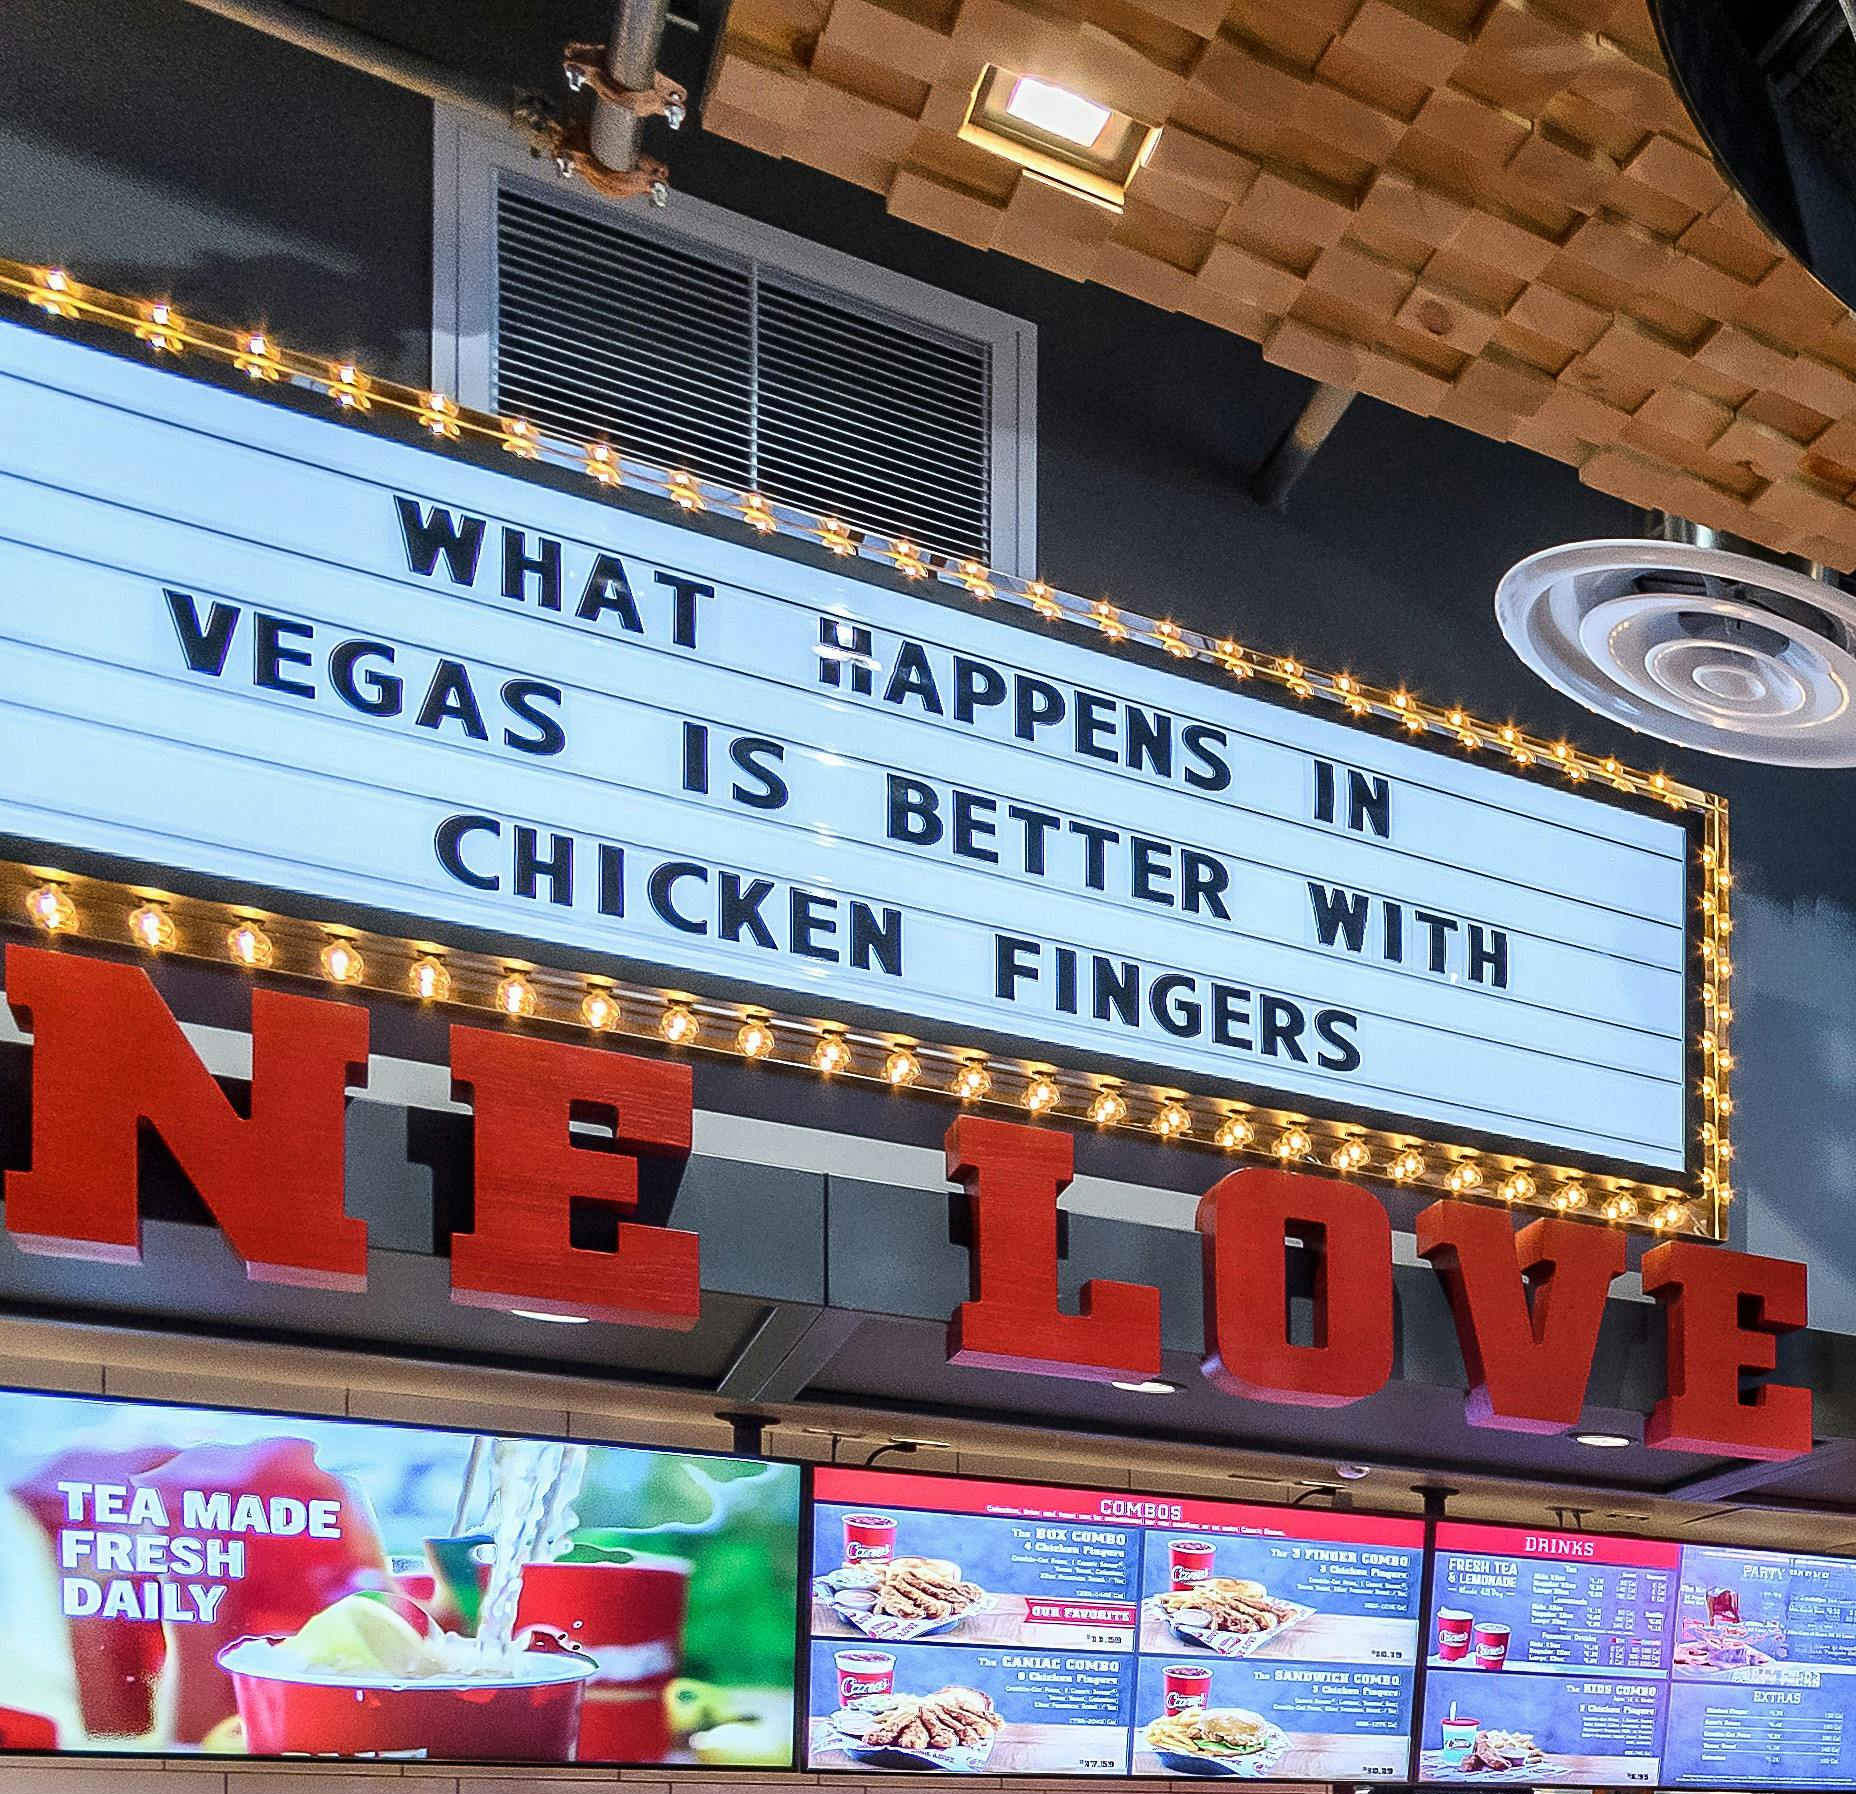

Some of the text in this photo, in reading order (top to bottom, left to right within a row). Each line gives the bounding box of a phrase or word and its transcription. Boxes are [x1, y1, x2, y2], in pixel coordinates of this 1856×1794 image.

[392, 495, 1391, 838] WHAT HAPPENS IN
[163, 588, 1510, 989] VEGAS IS BETTER WITH
[434, 815, 1361, 1072] CHICKEN FINGERS
[944, 1114, 1813, 1462] LOVE
[57, 1481, 342, 1540] TEA MADE
[1100, 1499, 1183, 1521] COMBOS
[1035, 1527, 1067, 1541] BOX
[1071, 1530, 1127, 1546] COMBO
[1525, 1536, 1595, 1556] DRINKS
[60, 1531, 245, 1580] FRESH
[1304, 1548, 1357, 1563] FINGER
[1361, 1552, 1409, 1567] COMBO
[1448, 1557, 1491, 1574] FRESH
[1494, 1560, 1518, 1576] TEA
[1743, 1564, 1785, 1580] PARTY
[1459, 1573, 1517, 1589] LEMONADE
[62, 1578, 227, 1624] DAILY
[1031, 1605, 1060, 1618] OUR
[1001, 1655, 1061, 1670] CANIAC
[1065, 1658, 1120, 1672] COMBO
[1274, 1669, 1350, 1684] SANDWICH
[1353, 1672, 1401, 1686] COMBO
[1583, 1683, 1613, 1695] KIDS
[1616, 1685, 1657, 1697] COMBO
[1753, 1690, 1801, 1704] EXTRAS
